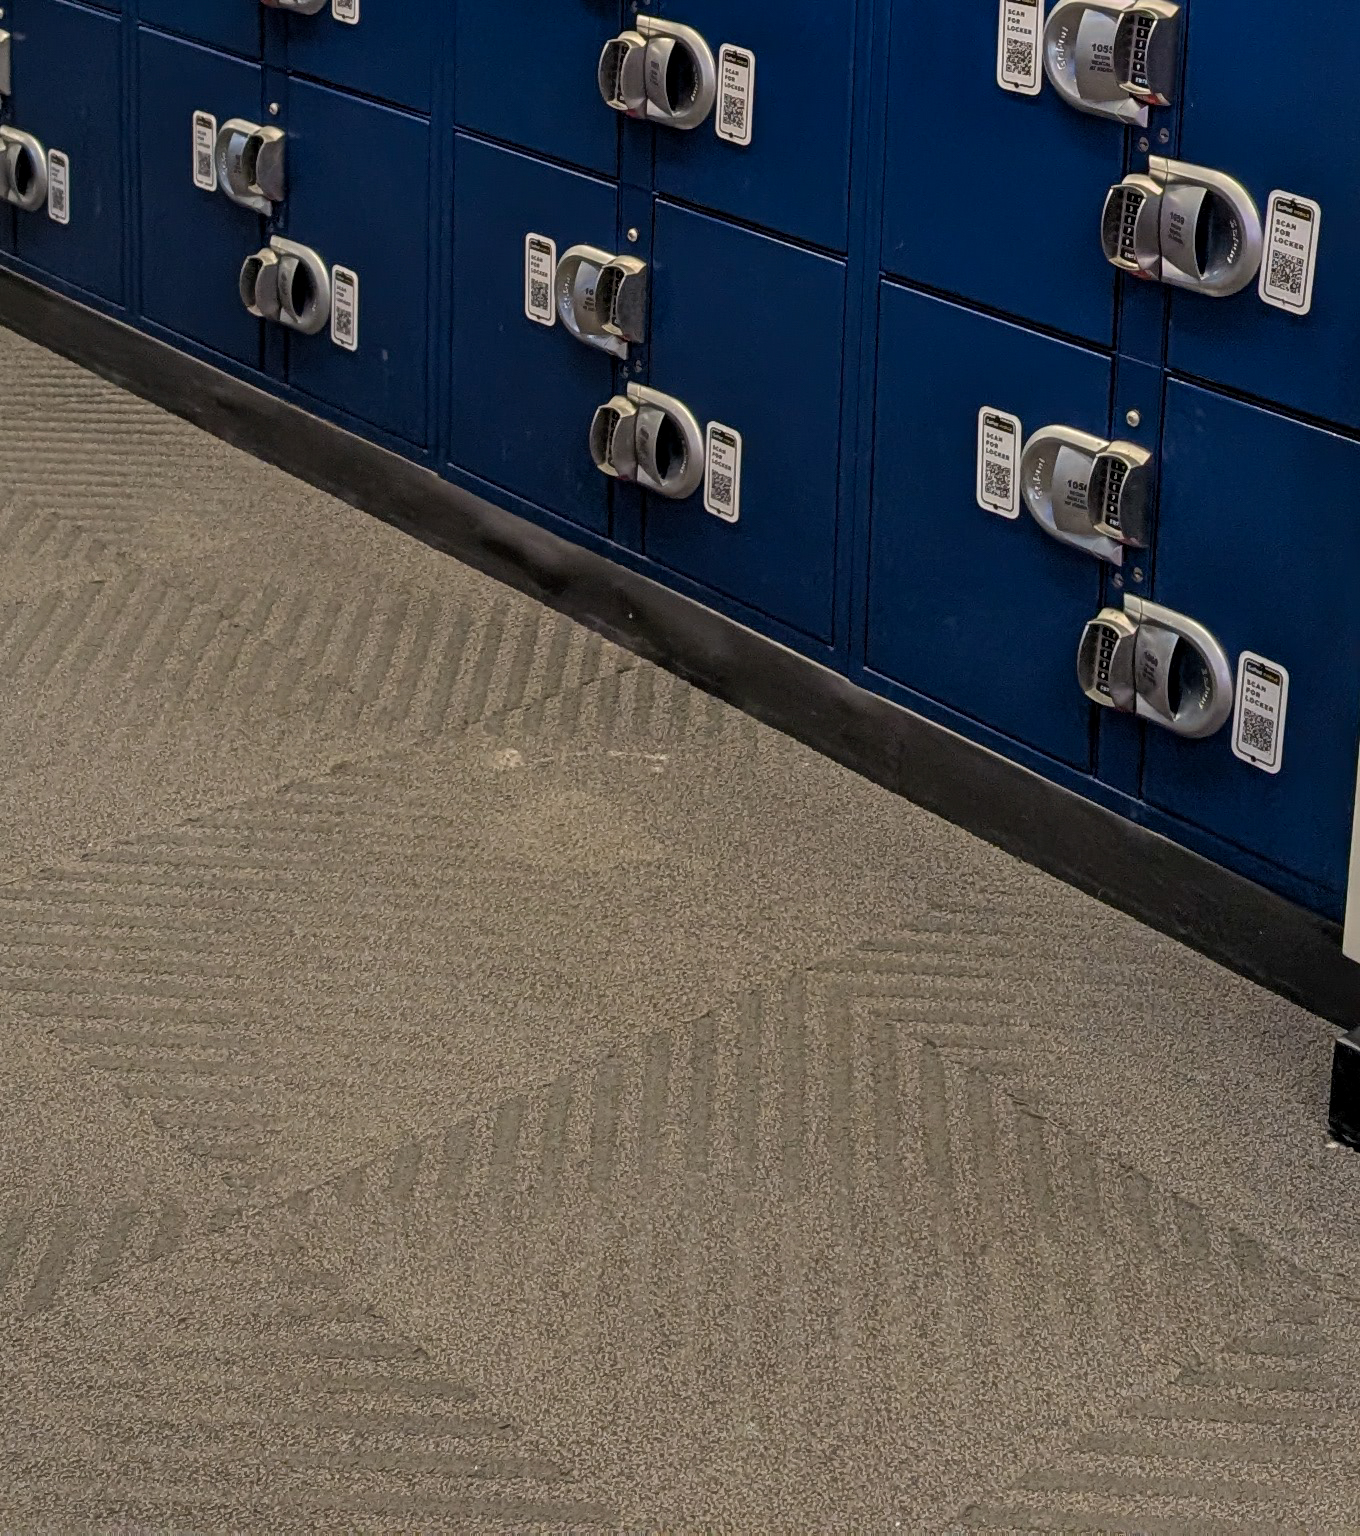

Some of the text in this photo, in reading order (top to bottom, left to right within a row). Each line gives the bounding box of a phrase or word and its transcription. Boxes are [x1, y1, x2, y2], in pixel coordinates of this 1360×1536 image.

[1007, 25, 1032, 35] LOCKER
[1276, 219, 1297, 230] SCAN
[1275, 227, 1290, 237] FOR
[1274, 236, 1304, 251] LOCKER
[1245, 695, 1274, 713] LOCKER
